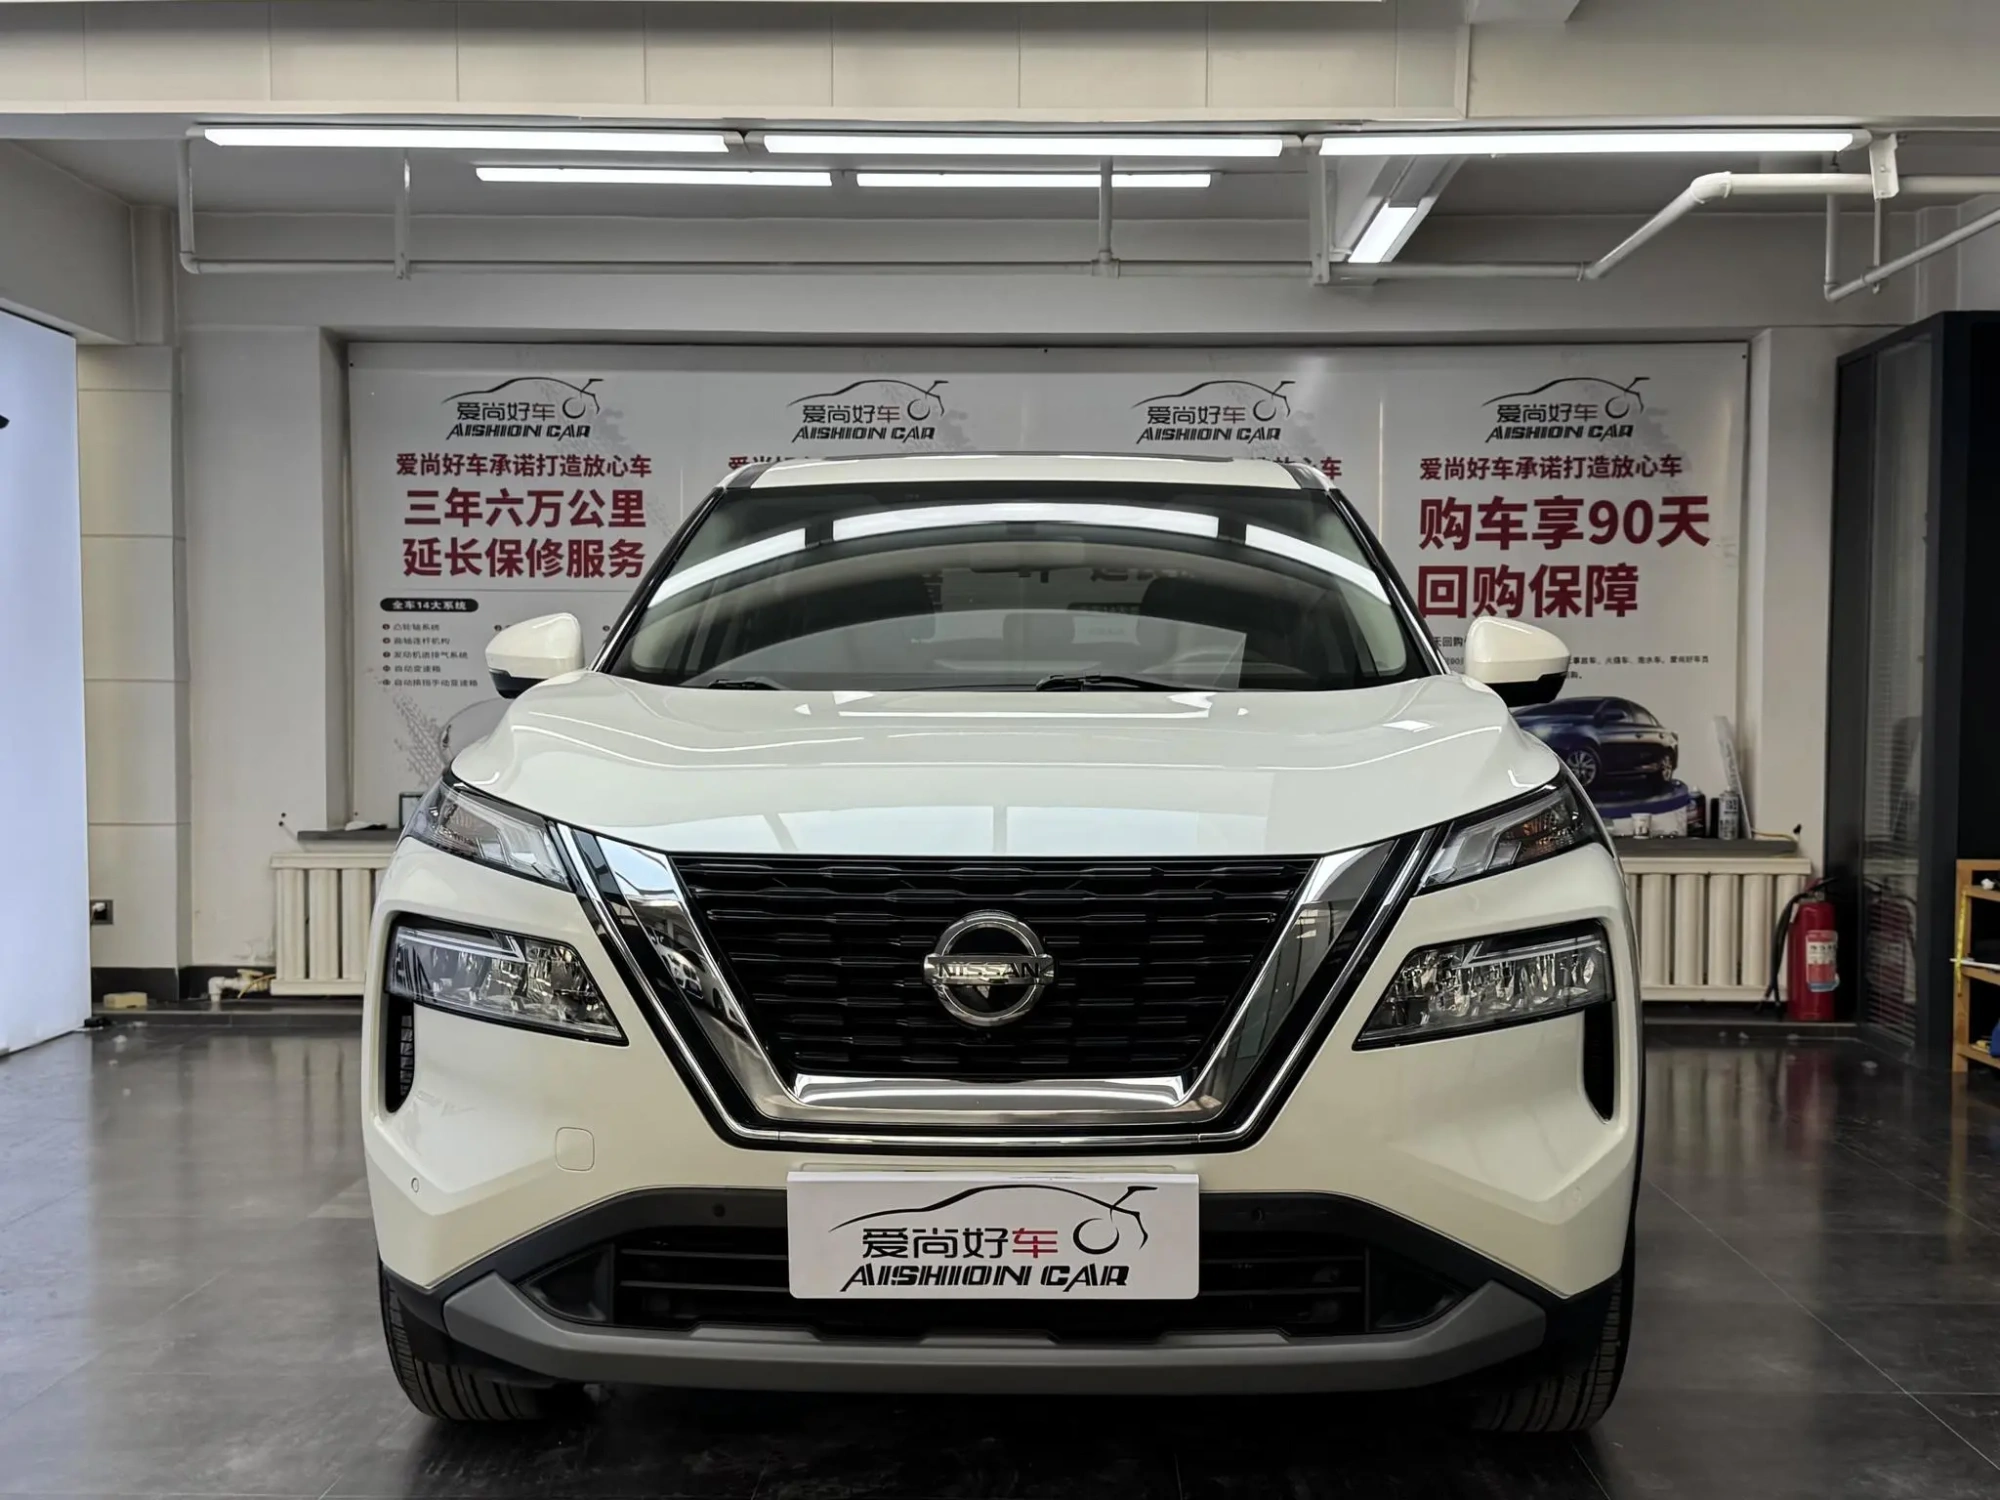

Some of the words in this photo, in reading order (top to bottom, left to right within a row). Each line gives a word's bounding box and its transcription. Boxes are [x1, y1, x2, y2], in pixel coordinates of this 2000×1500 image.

[457, 402, 556, 421] 爱尚好车
[802, 404, 900, 424] 爱尚好车
[1147, 405, 1246, 425] 爱尚好车
[1497, 403, 1598, 423] 爱尚好车
[446, 423, 543, 441] AISHION
[546, 423, 591, 441] CAR
[791, 426, 888, 443] AISHION
[890, 425, 936, 443] CAR
[1136, 427, 1233, 444] AISHION
[1235, 426, 1282, 444] CAR
[1485, 424, 1584, 443] AISHION
[1588, 423, 1634, 442] CAR
[396, 453, 652, 478] 爱尚好车承诺打造放心车
[1420, 454, 1683, 481] 爱尚好车承诺打造放心车
[404, 487, 647, 528] 三年六万公里
[1419, 495, 1711, 551] 购车享90天
[403, 537, 647, 579] 延长保修服务
[1416, 563, 1640, 619] 回购保障
[1434, 635, 1467, 648] 天回购
[939, 962, 1041, 978] NISSAN
[862, 1226, 1059, 1260] 爱尚好车
[839, 1263, 1034, 1293] AISHION
[1038, 1262, 1131, 1293] CAR
